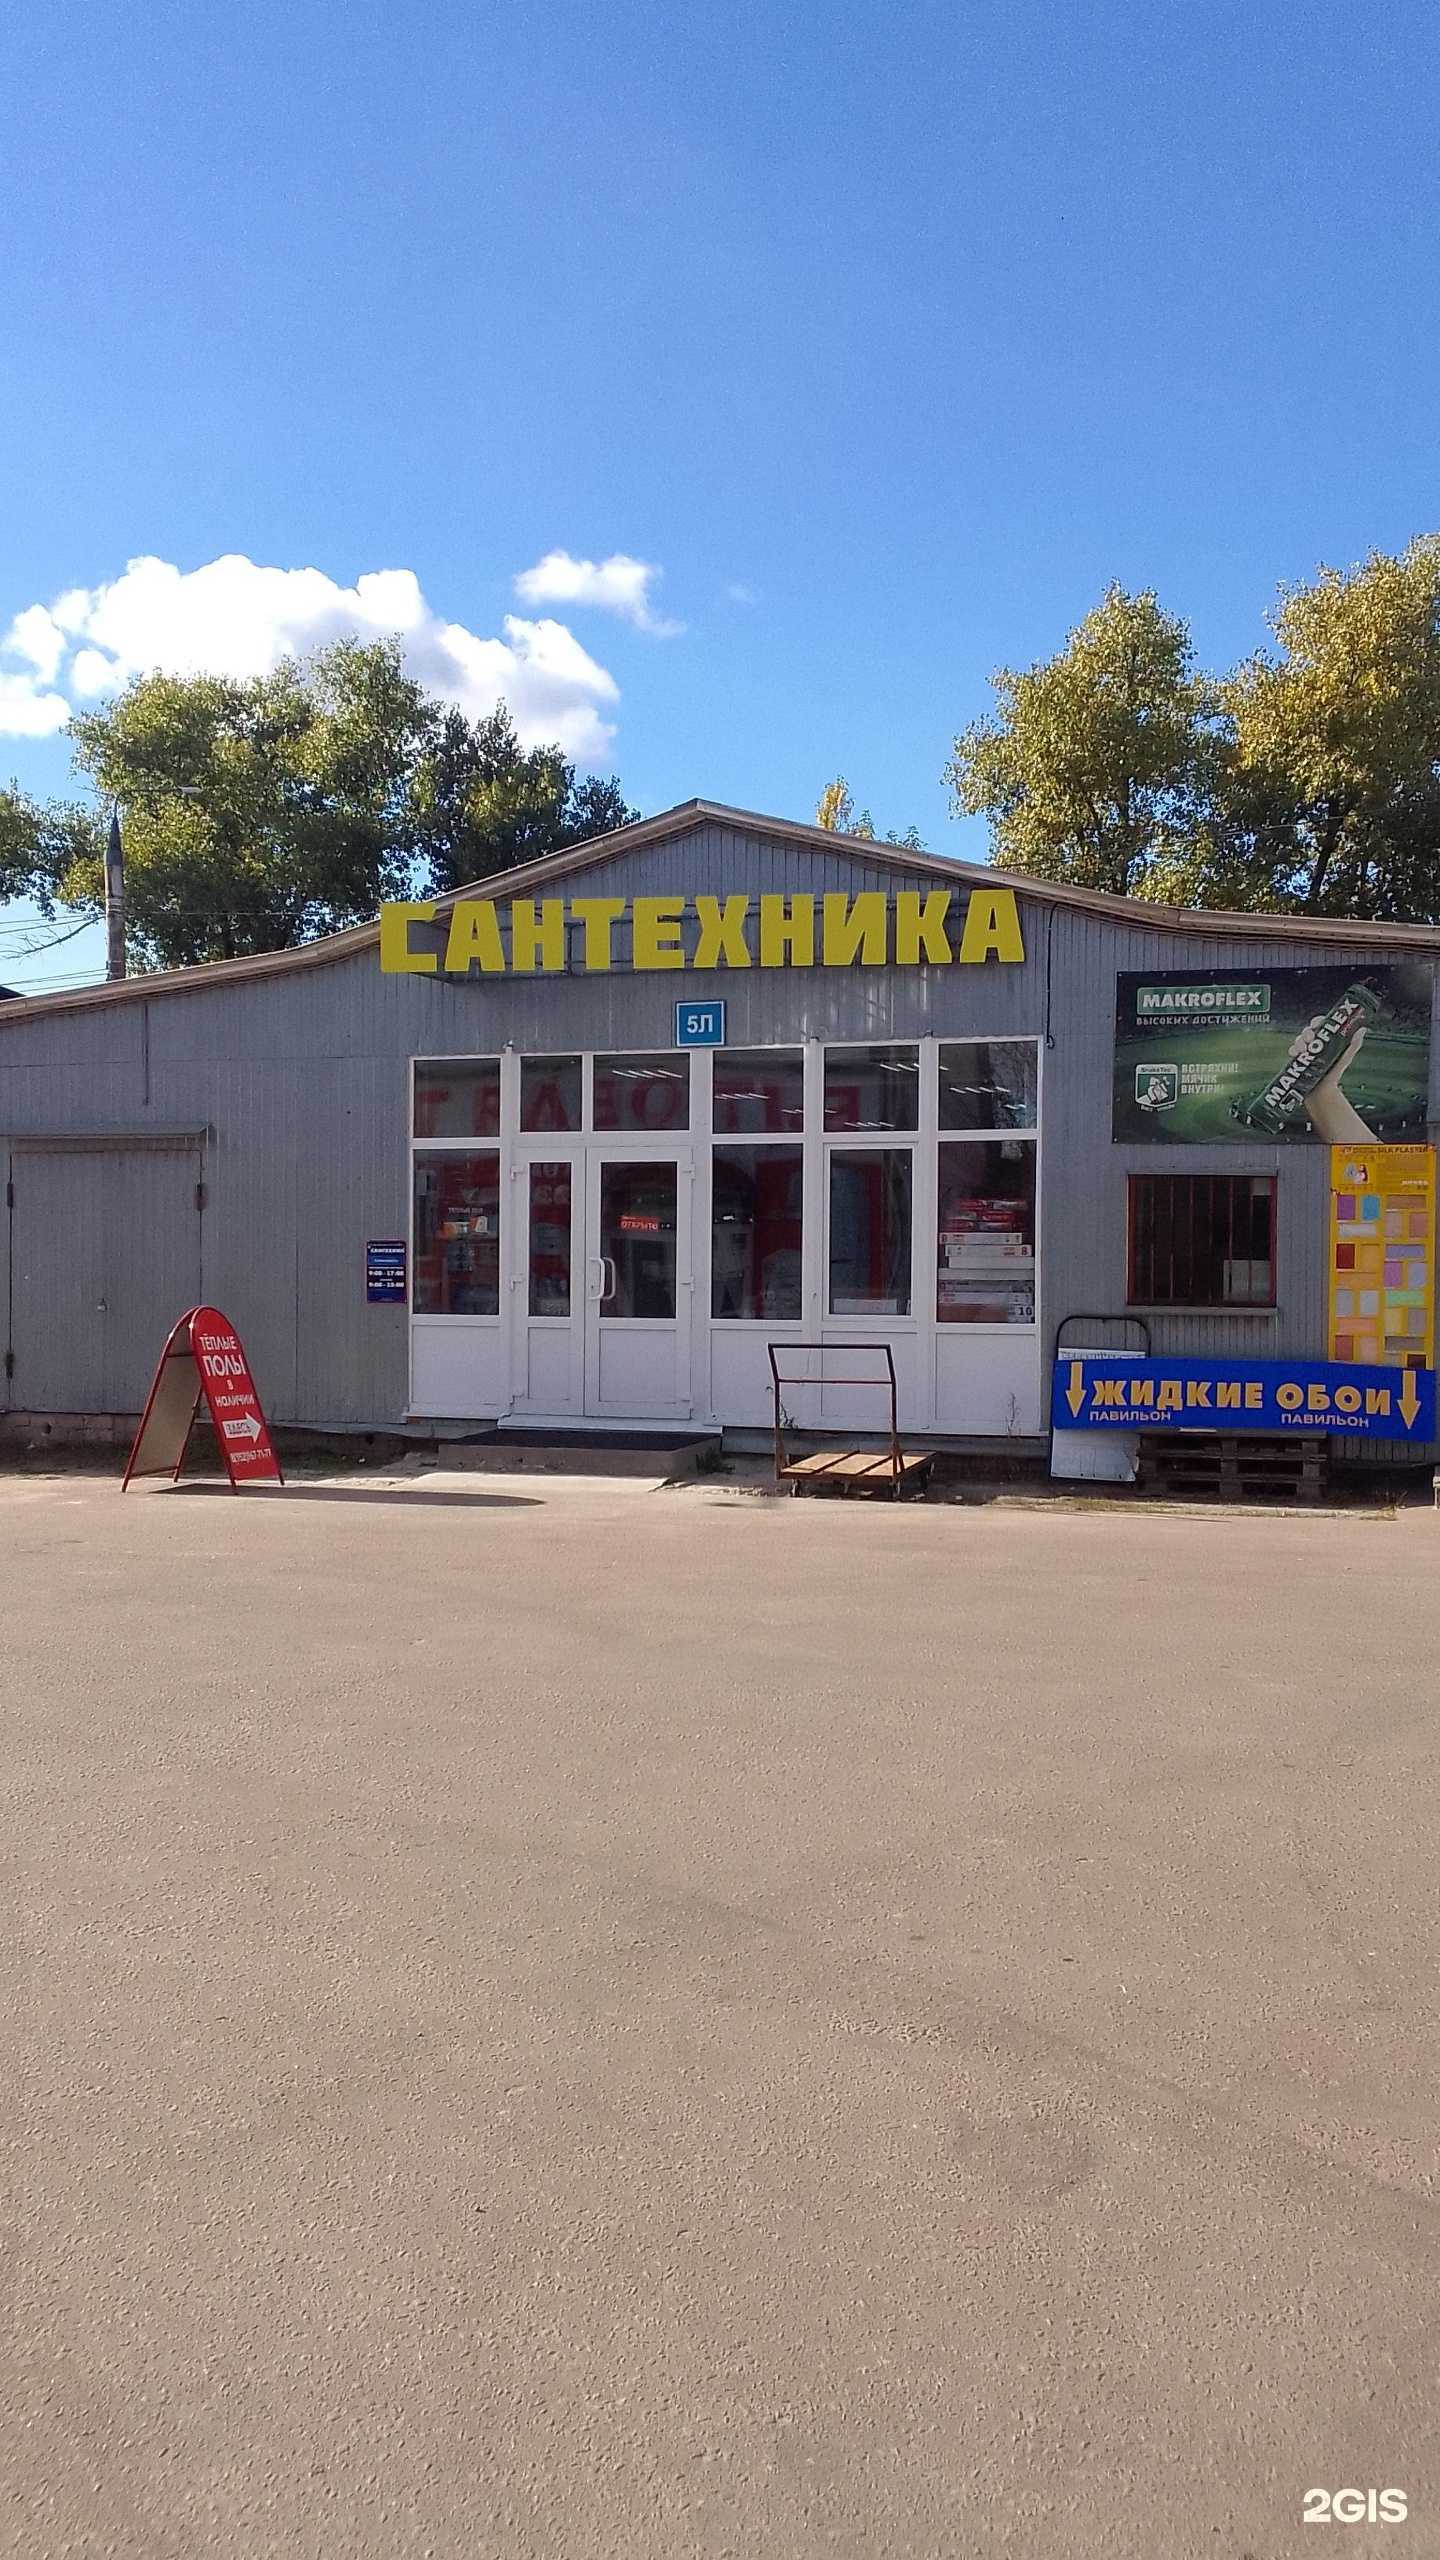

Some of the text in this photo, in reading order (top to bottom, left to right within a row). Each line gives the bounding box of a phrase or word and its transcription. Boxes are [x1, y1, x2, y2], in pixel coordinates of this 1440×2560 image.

[380, 889, 1025, 973] САНТЕХНИКА
[1142, 991, 1262, 1008] MAKROFLEX
[686, 1015, 715, 1035] 5Л
[1136, 1014, 1271, 1026] ВЫСОКИХ ДОСТИЖЕНИЙ
[1264, 998, 1360, 1107] MAKROFLEX
[202, 1354, 247, 1377] ПОЛЫ
[1091, 1379, 1391, 1416] ЖИДКИЕ ОБОИ
[1089, 1410, 1172, 1422] ПАВИЛЬОН
[1281, 1412, 1370, 1428] ПАВИЛЬОН
